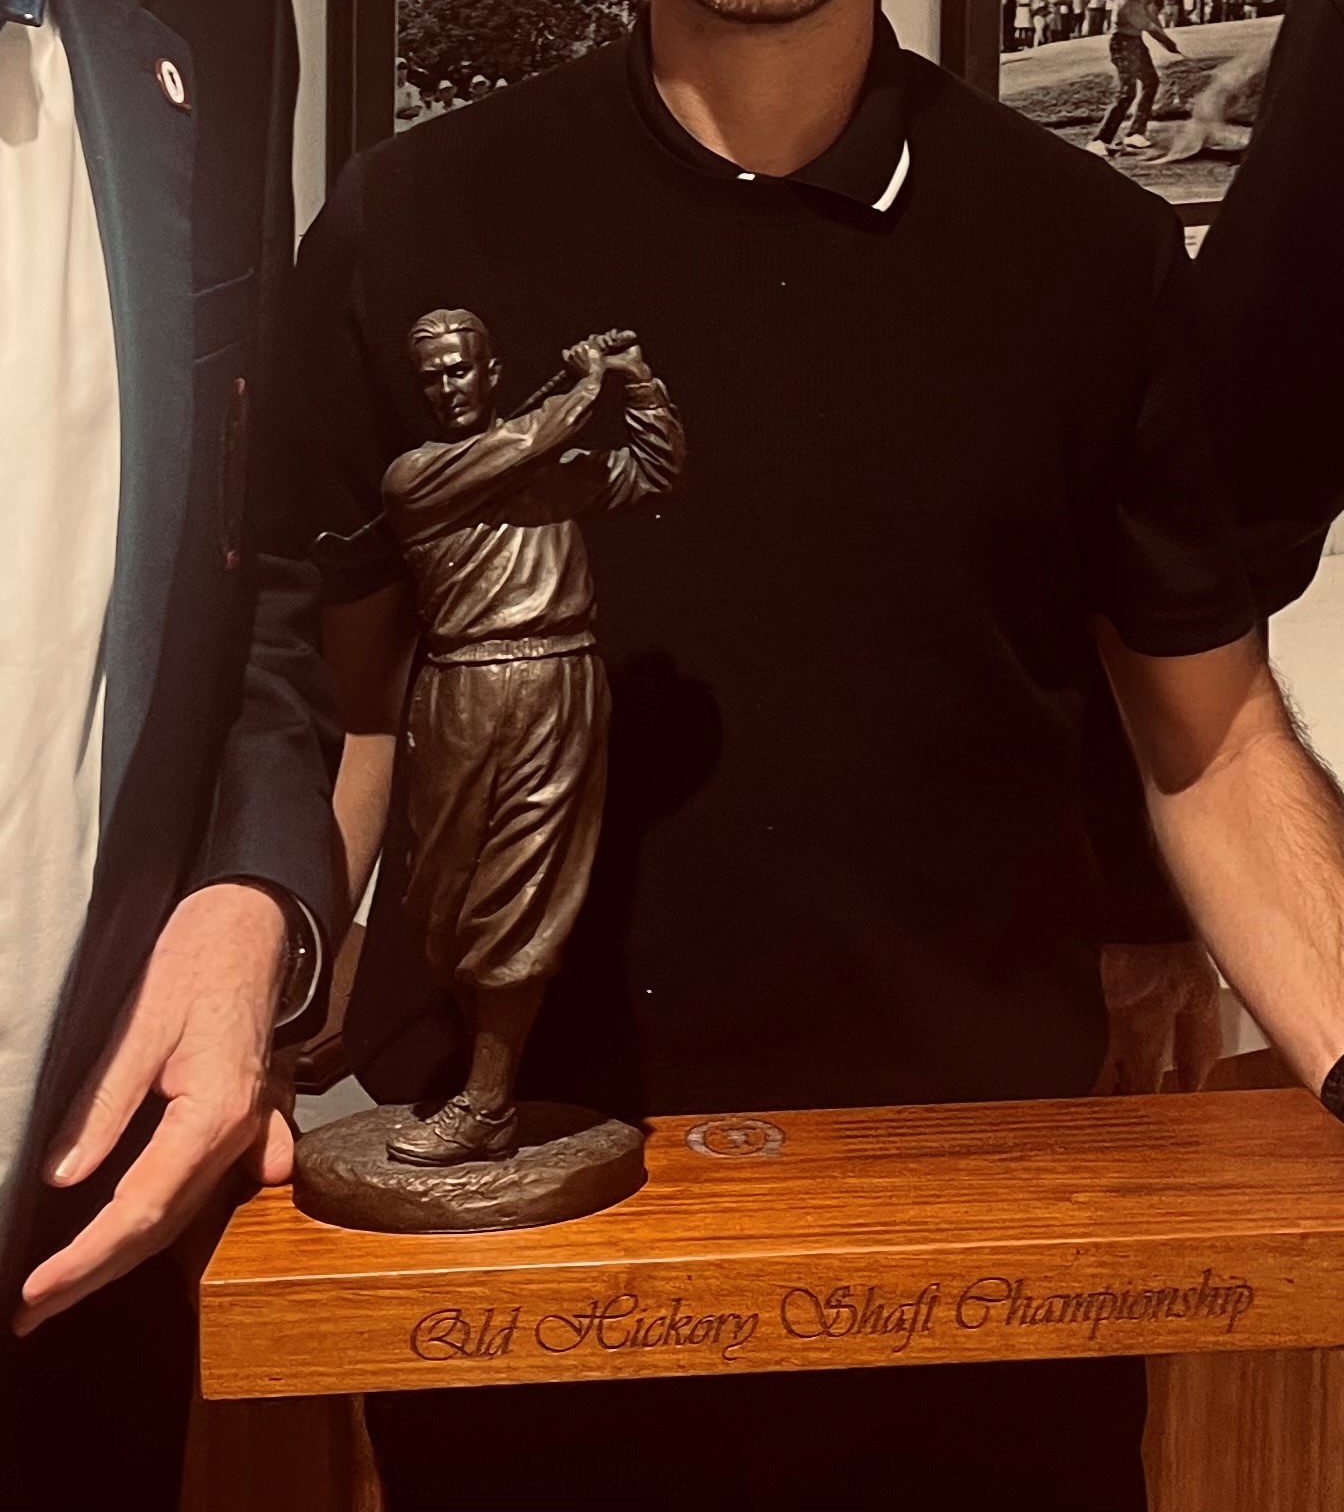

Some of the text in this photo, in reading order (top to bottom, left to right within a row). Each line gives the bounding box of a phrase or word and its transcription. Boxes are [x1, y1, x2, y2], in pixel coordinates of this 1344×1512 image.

[410, 1268, 1255, 1361] Old Hickory Shaft Championship
